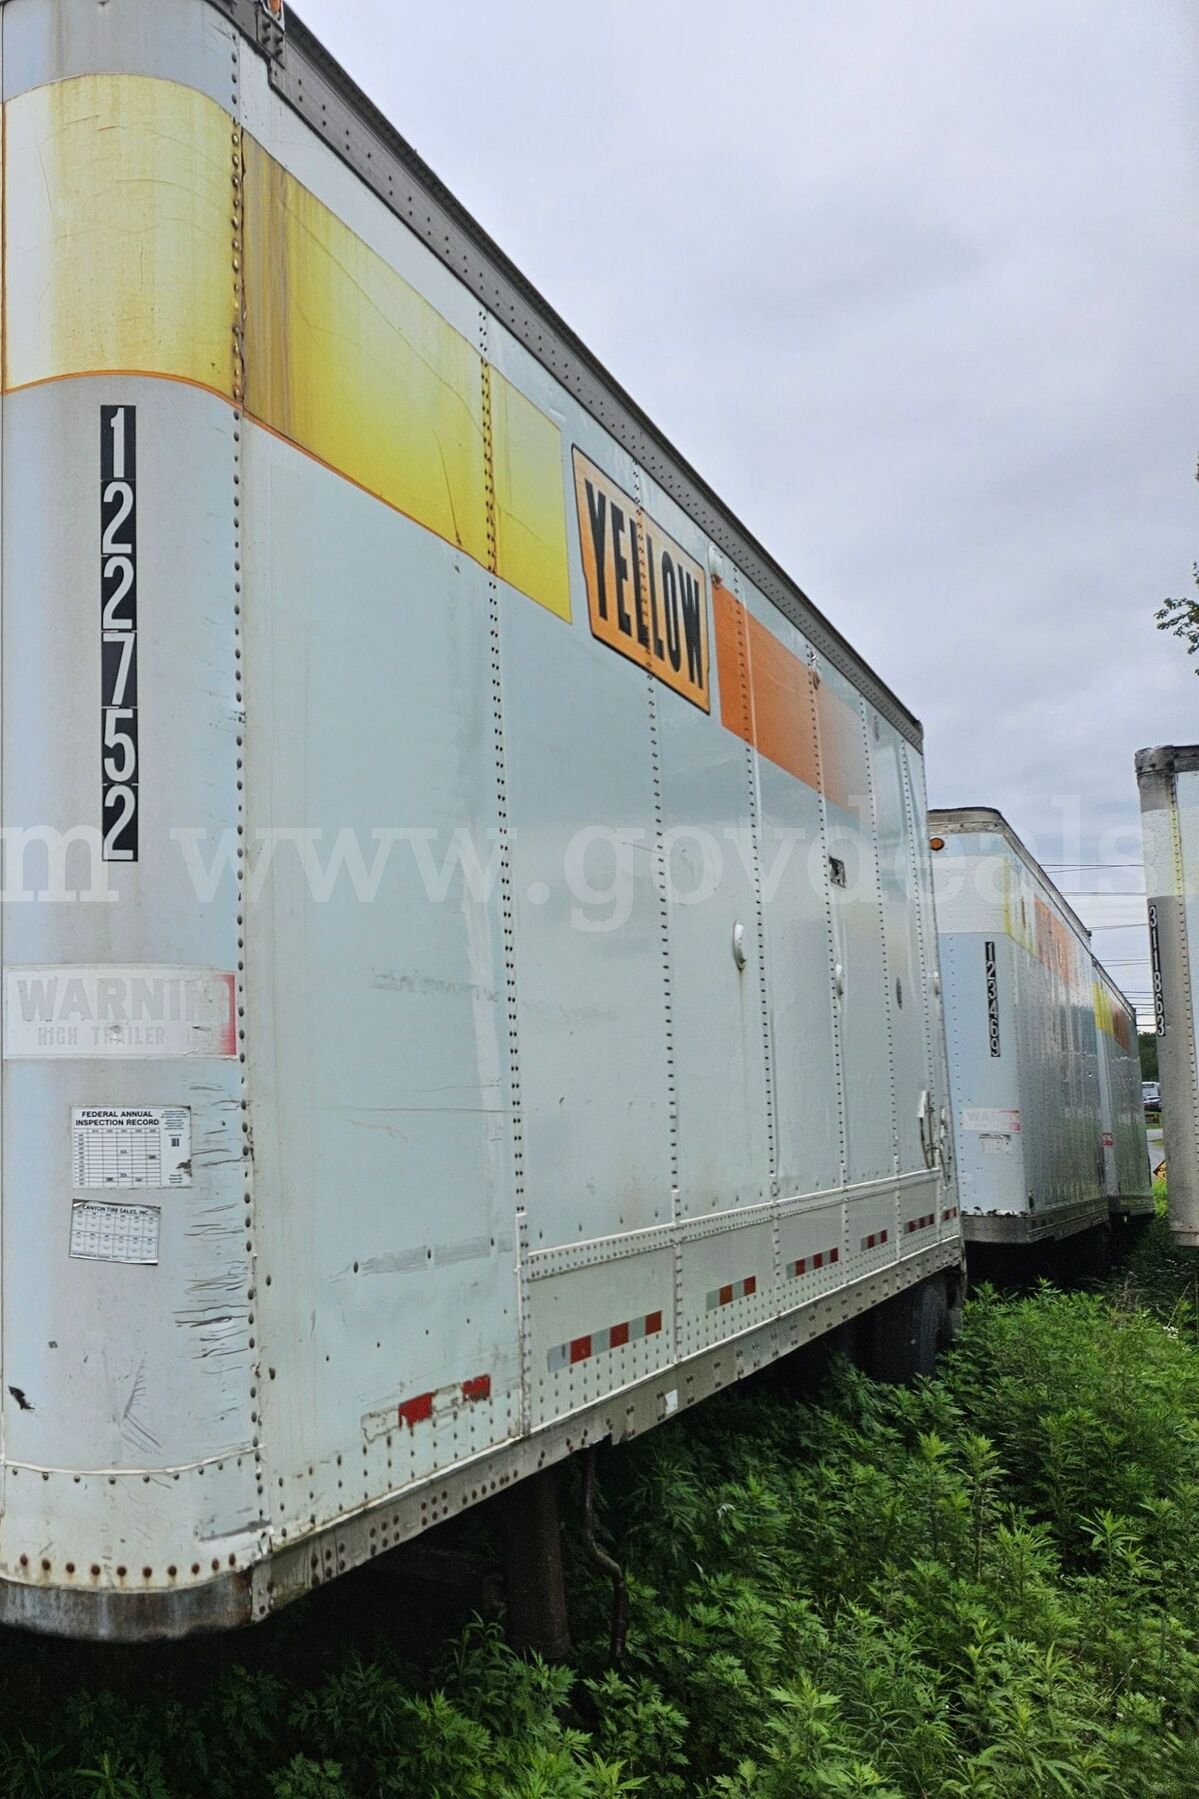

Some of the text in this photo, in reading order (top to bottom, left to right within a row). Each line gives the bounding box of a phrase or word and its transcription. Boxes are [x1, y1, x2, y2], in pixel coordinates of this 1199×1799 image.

[101, 407, 137, 861] 122752
[584, 478, 704, 690] YELLOW
[986, 942, 1000, 1057] 123469
[1149, 905, 1165, 1036] 311863
[36, 1026, 78, 1046] HIGH
[91, 1026, 166, 1046] TRAILER
[75, 1118, 160, 1126] INSPECTION RECORD
[81, 1110, 153, 1118] FEDERAL ANNUAL
